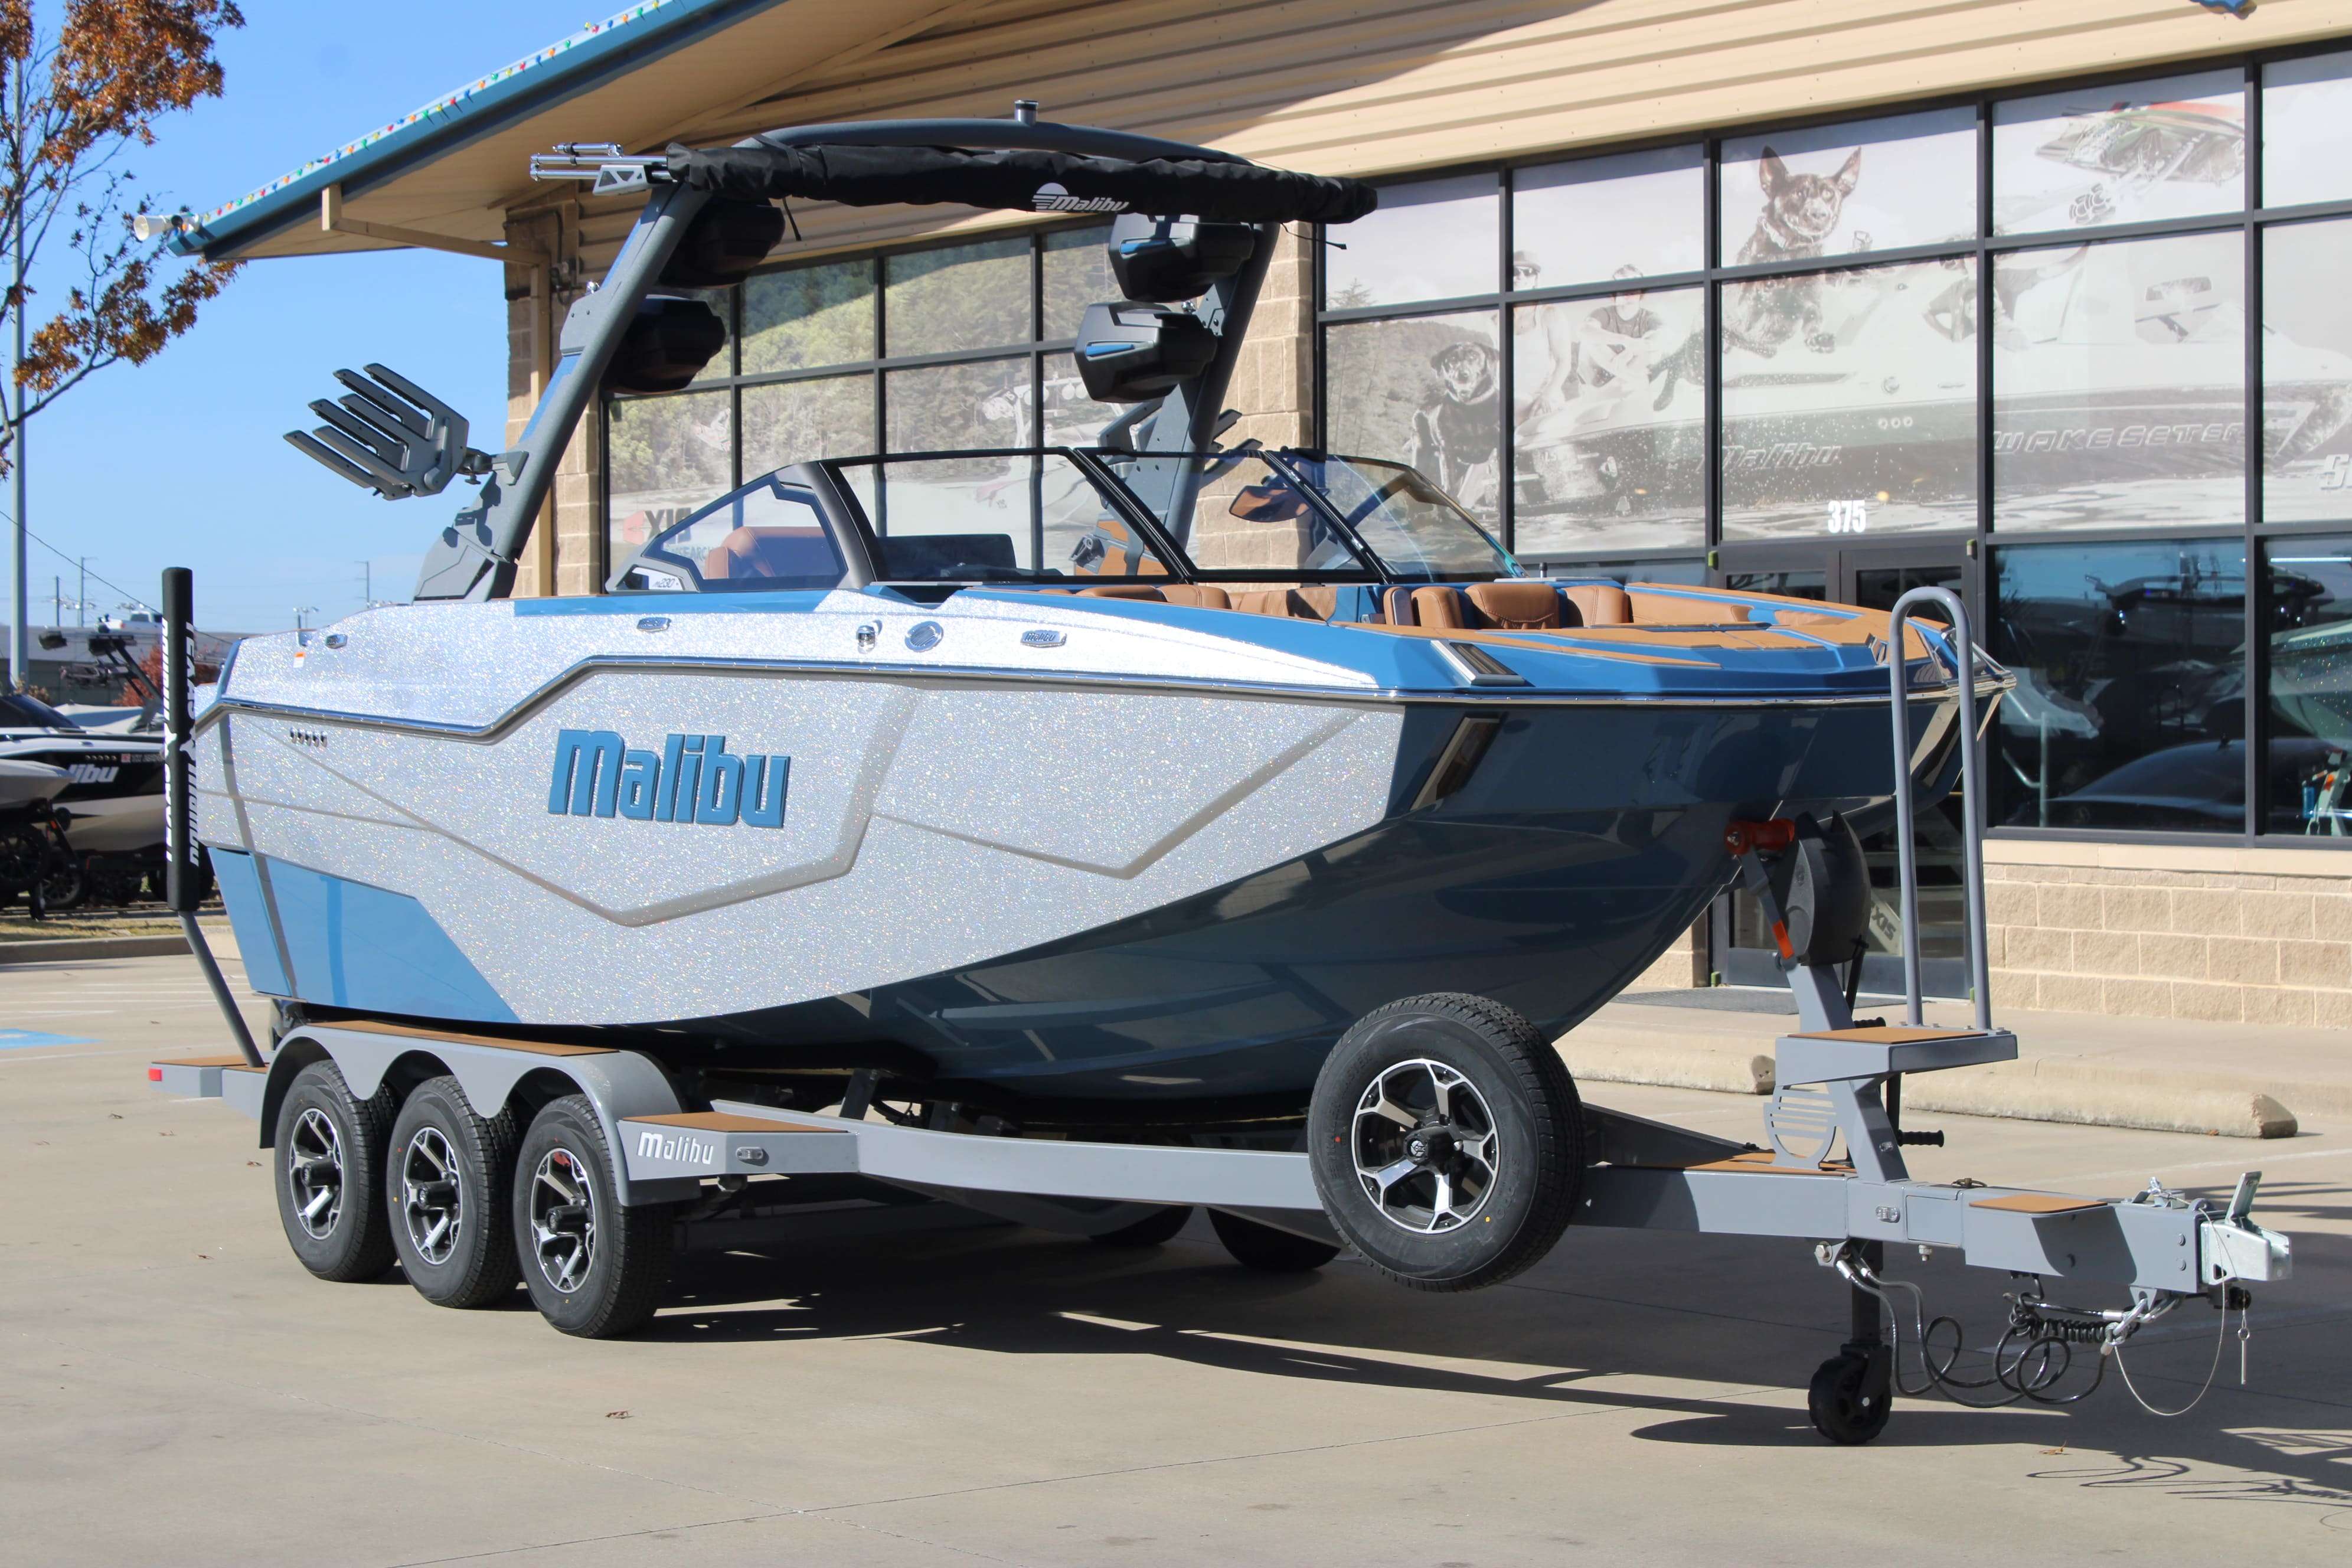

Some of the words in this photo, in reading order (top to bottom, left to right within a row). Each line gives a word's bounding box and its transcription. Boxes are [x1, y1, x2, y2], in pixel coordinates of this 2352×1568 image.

[1048, 195, 1130, 212] Malibu
[1827, 499, 1866, 534] 375
[547, 729, 791, 829] Malibu
[637, 1131, 714, 1165] Malibu
